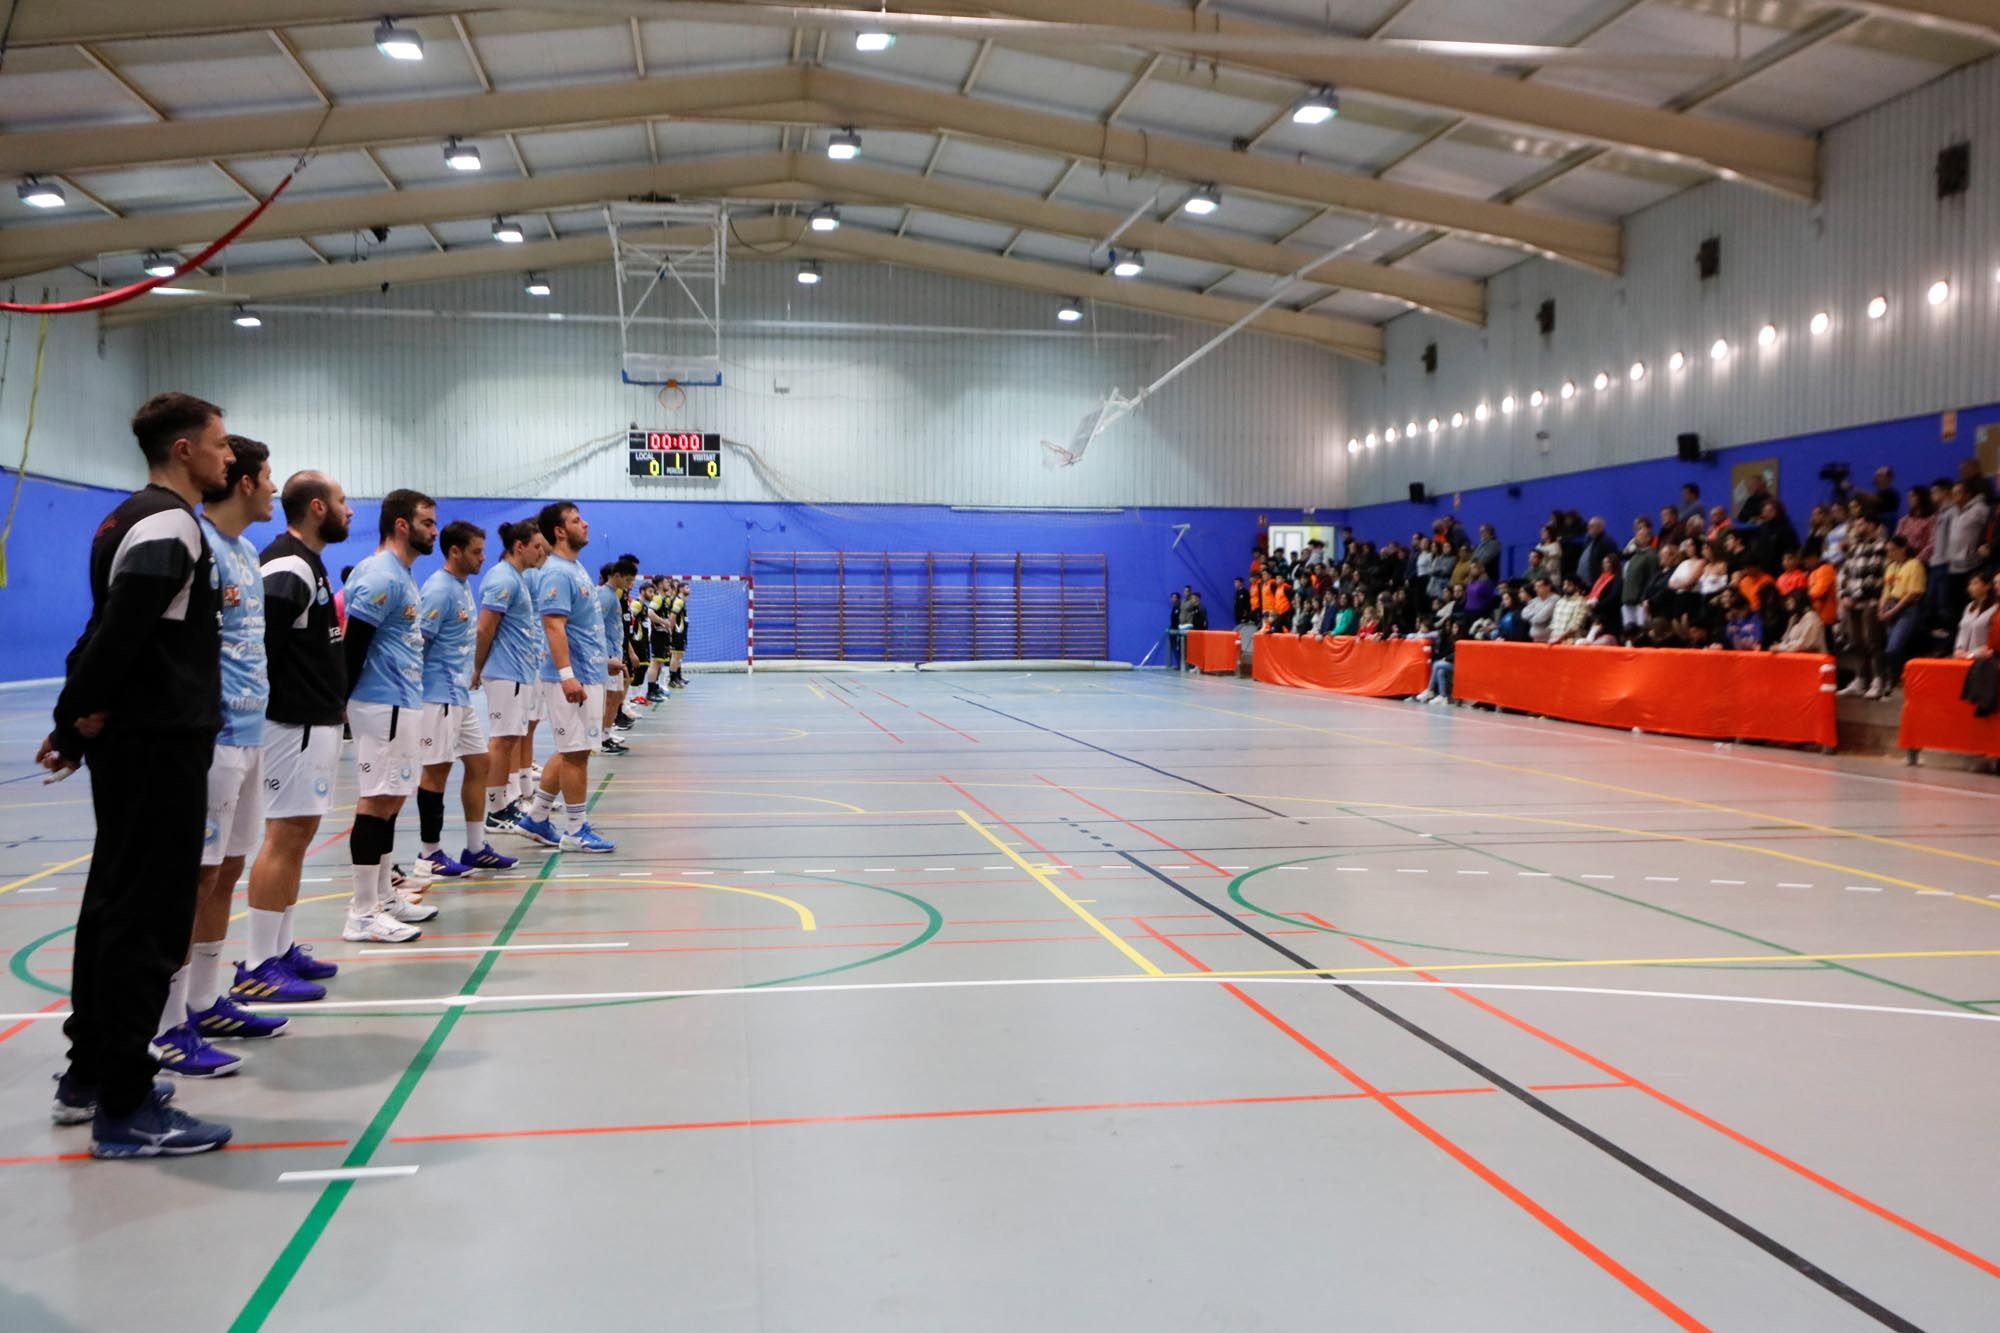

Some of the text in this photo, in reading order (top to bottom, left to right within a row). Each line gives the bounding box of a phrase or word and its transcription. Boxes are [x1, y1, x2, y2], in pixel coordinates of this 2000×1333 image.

[650, 433, 700, 450] 00:00
[635, 452, 654, 460] LOCAL
[675, 452, 680, 469] 1
[650, 459, 659, 476] 0
[707, 461, 717, 477] 0
